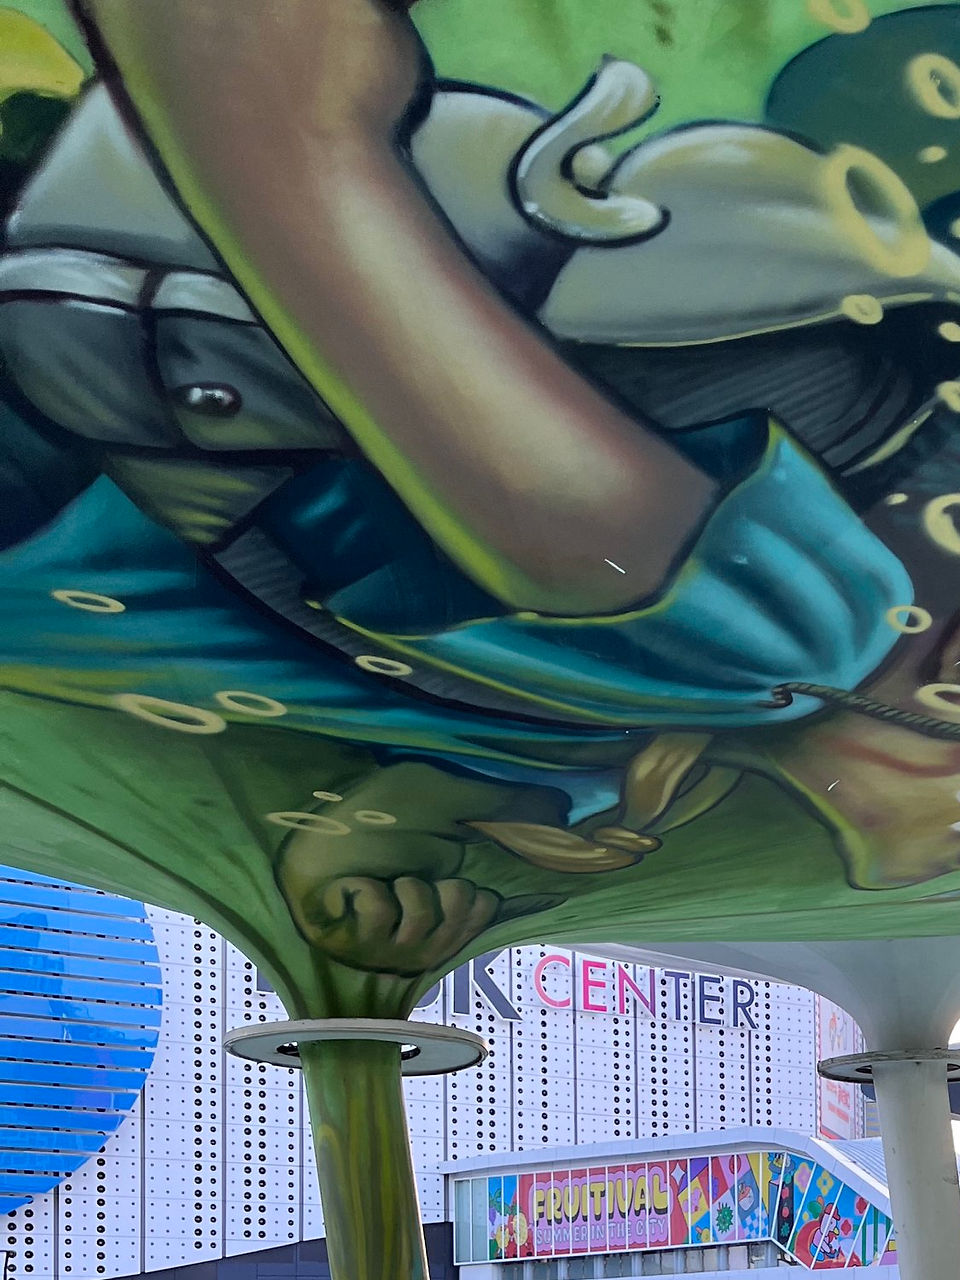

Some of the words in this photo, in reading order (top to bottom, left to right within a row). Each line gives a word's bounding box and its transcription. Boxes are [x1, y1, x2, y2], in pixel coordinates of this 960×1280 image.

[534, 955, 758, 1030] CENTER
[534, 1174, 669, 1225] FRUITIVAL
[536, 1227, 588, 1245] SUMMER
[590, 1223, 606, 1240] IN
[608, 1221, 632, 1238] THE
[635, 1218, 666, 1236] CITY
